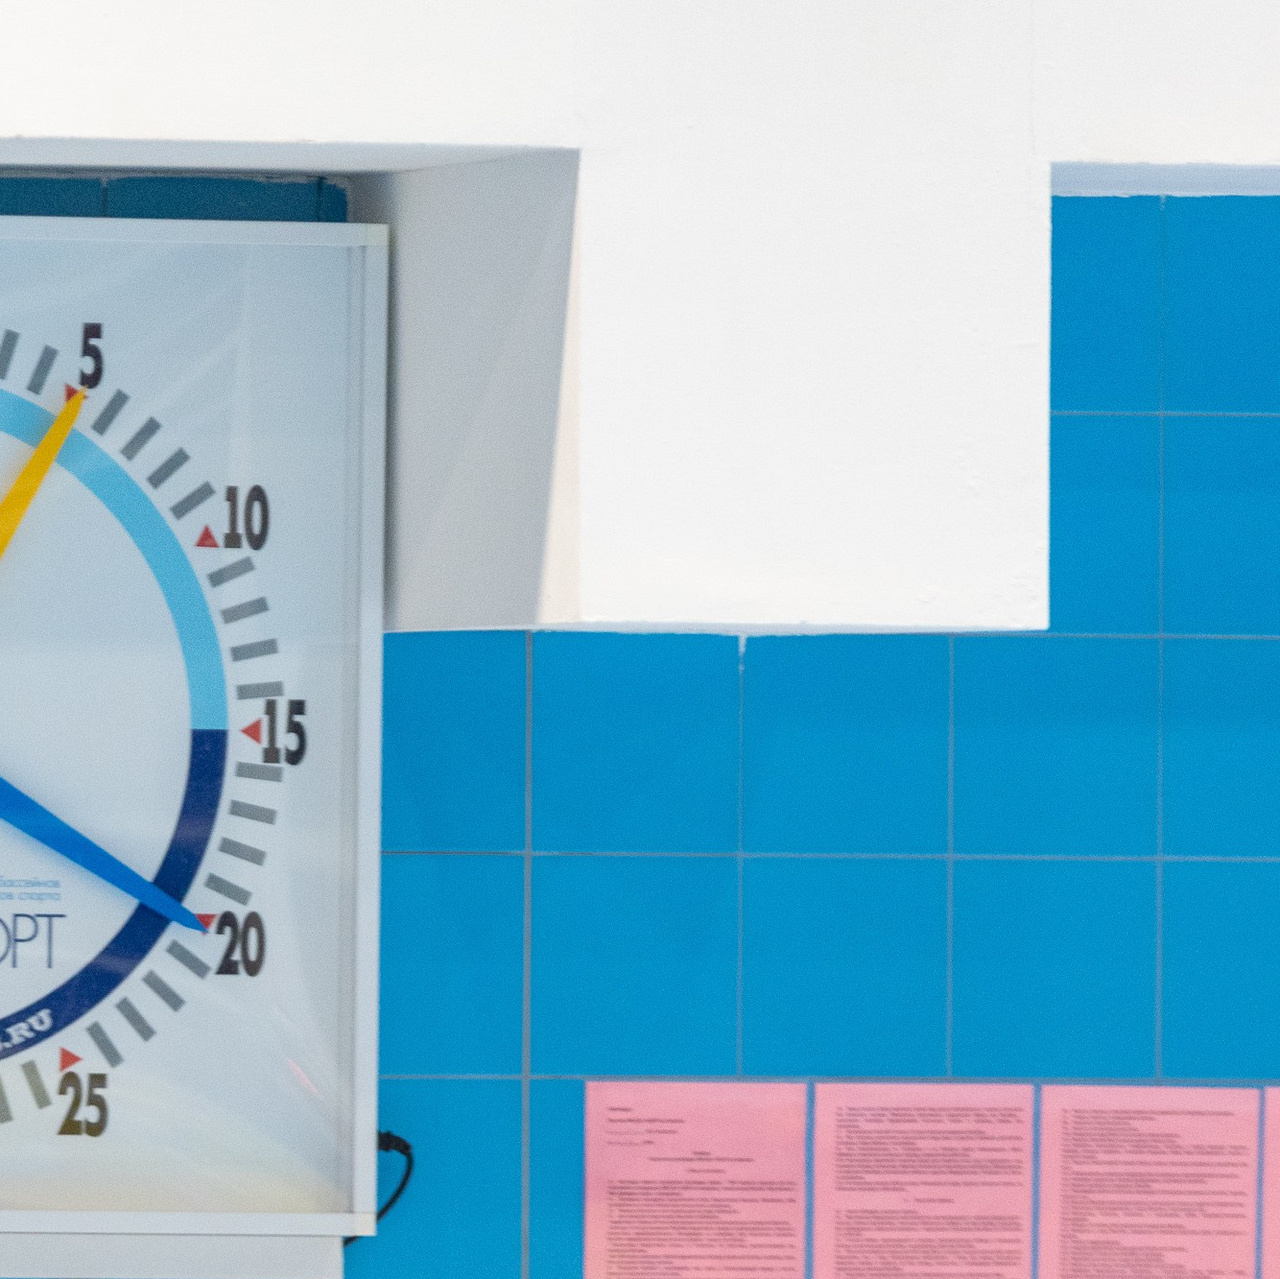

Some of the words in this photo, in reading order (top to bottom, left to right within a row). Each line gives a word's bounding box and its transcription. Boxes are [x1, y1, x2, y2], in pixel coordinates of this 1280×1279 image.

[79, 322, 104, 390] 5
[224, 484, 270, 551] 10
[263, 698, 307, 766] 15
[215, 910, 266, 977] 20
[58, 1071, 108, 1138] 25
